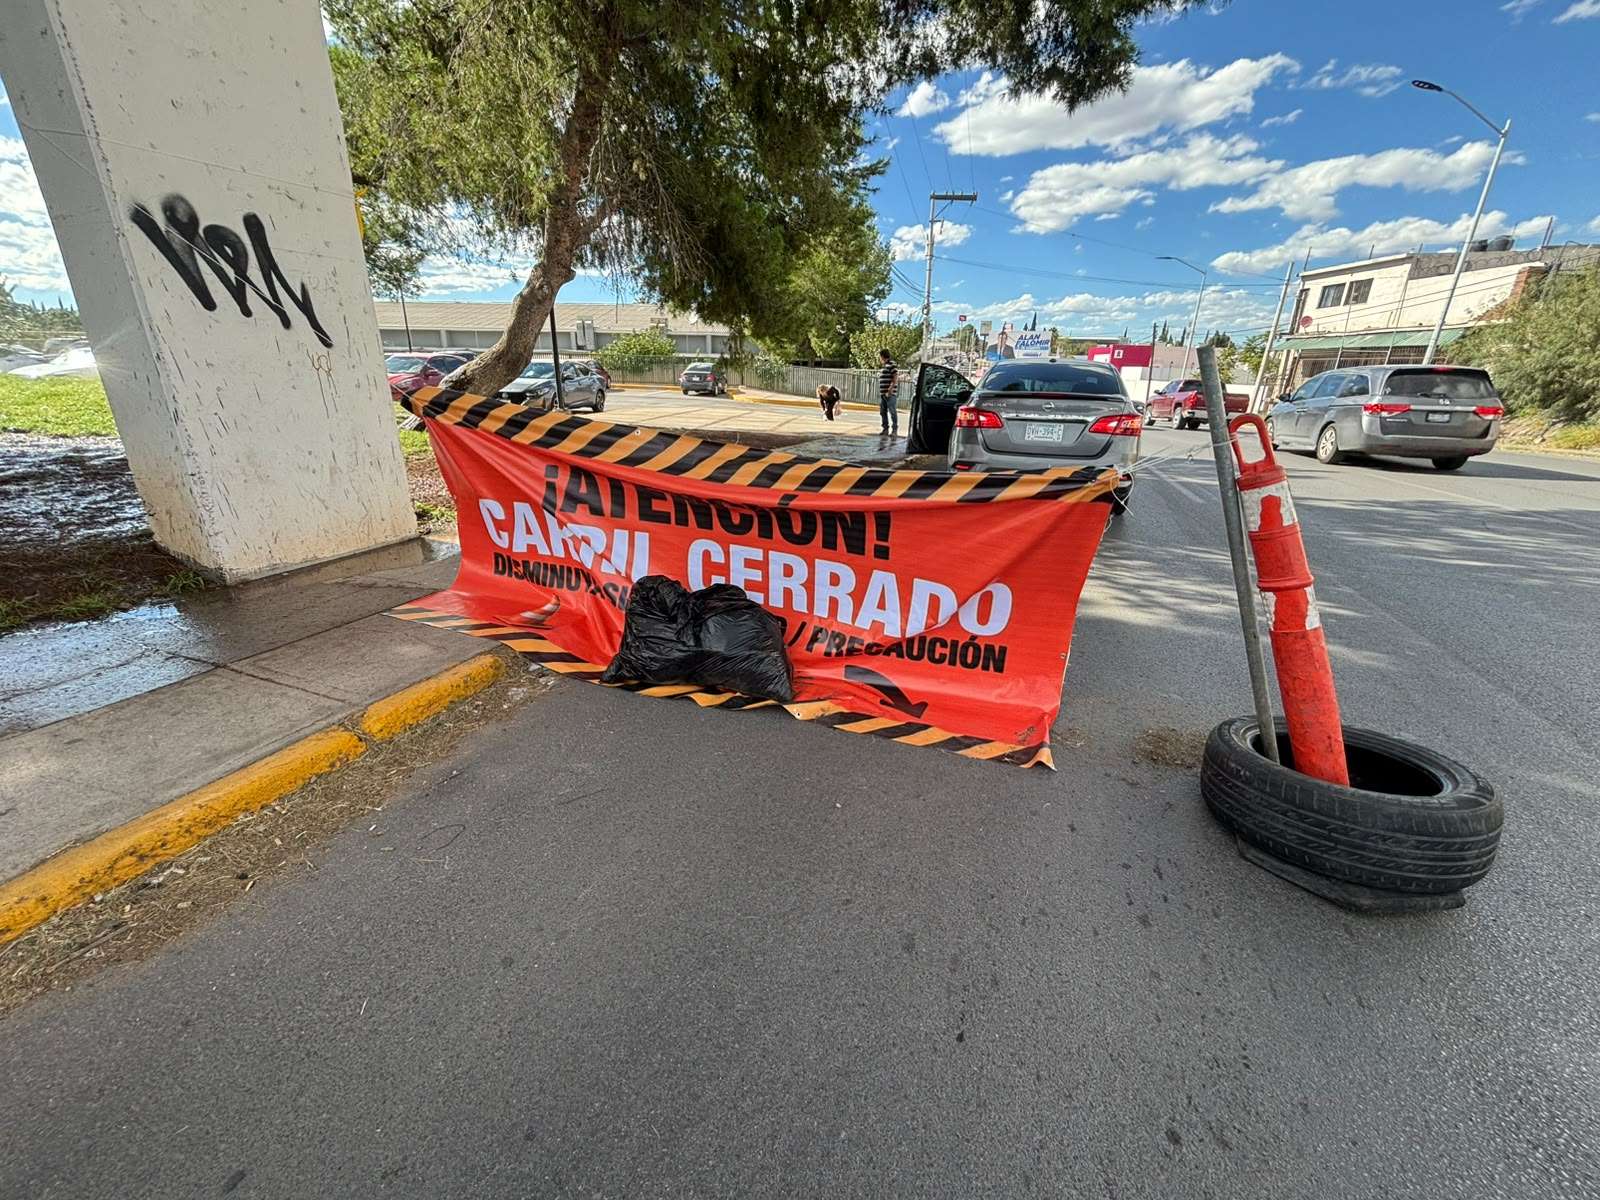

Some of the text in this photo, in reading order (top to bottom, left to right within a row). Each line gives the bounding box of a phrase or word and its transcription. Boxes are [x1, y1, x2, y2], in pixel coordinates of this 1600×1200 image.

[1018, 333, 1041, 341] ALAN
[687, 538, 1013, 638] CERRADO
[806, 625, 1008, 674] PRECAUCIÓN
